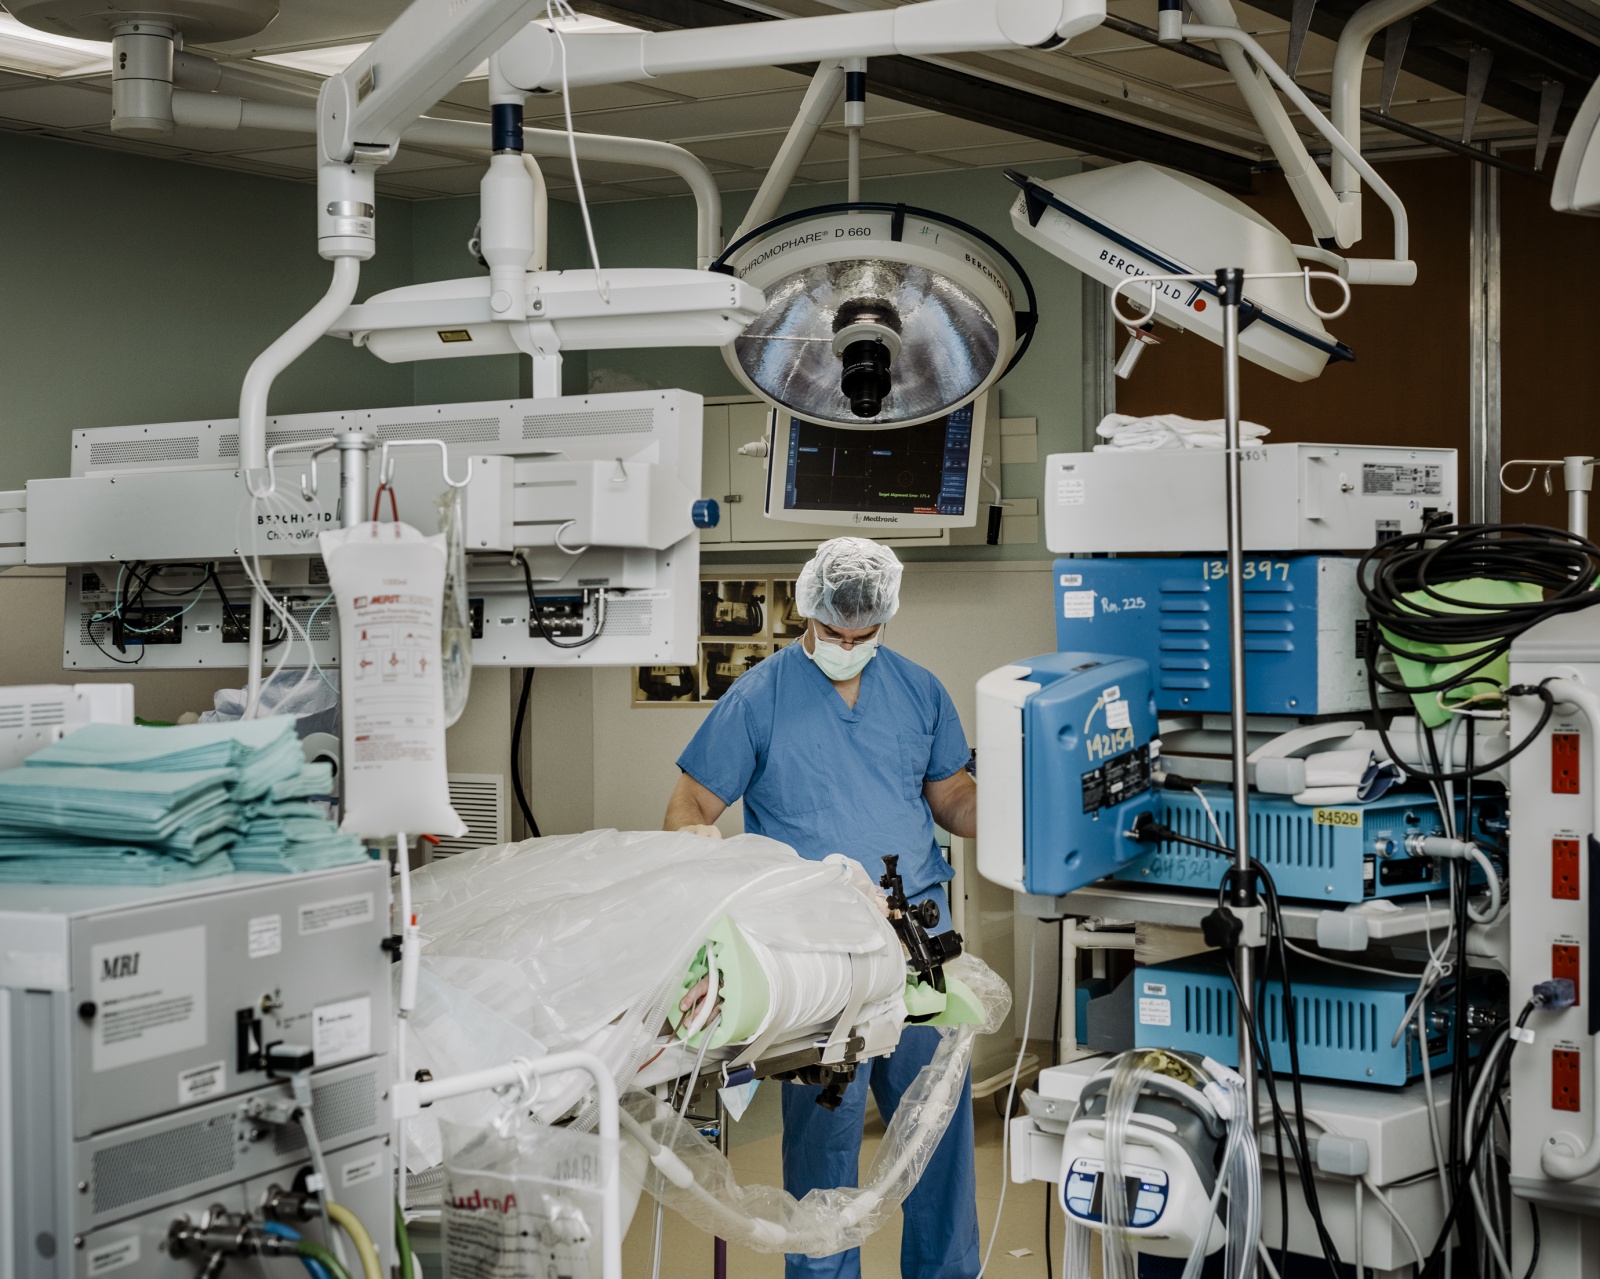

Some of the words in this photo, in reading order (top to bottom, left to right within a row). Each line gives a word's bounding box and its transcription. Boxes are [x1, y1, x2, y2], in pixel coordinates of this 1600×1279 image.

[835, 228, 845, 238] D
[848, 227, 872, 237] 660
[965, 253, 1009, 299] BERCHTOLD
[1099, 249, 1182, 300] BERCHOLD
[863, 515, 898, 523] Medtronic
[1203, 560, 1290, 582] 13397
[1122, 596, 1146, 610] 225
[1317, 810, 1359, 826] 84529
[100, 951, 140, 982] MRI
